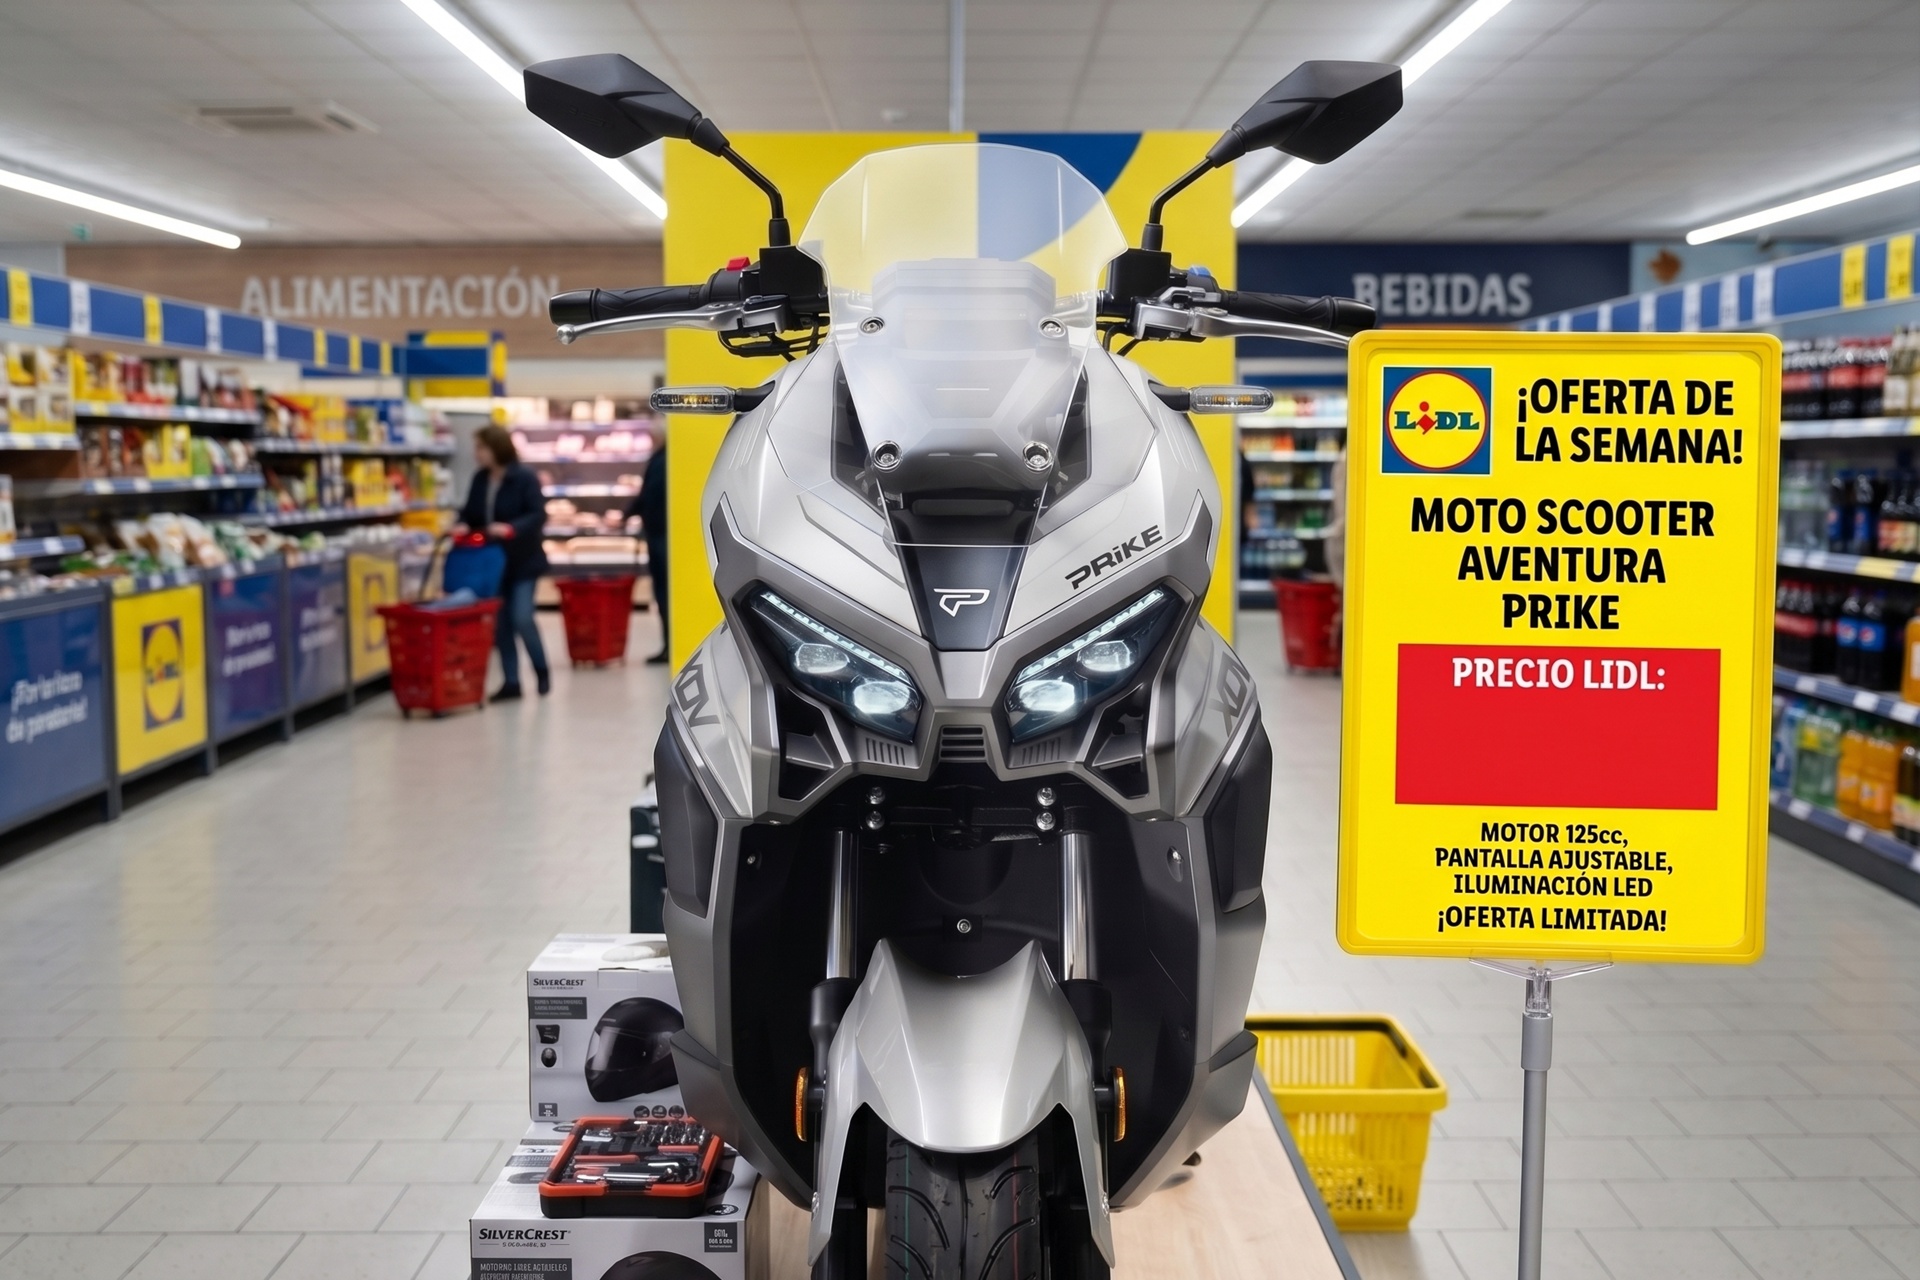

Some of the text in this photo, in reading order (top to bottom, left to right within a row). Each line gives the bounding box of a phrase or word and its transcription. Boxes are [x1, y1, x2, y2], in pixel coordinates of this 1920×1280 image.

[240, 266, 559, 318] ALIMENTACIÓN
[1352, 272, 1533, 317] BEBIDAS
[1517, 378, 1734, 423] ¡OFERTA DE
[1515, 426, 1743, 465] LA SEMANA!
[1411, 497, 1715, 537] MOTO SCOOTER
[1457, 545, 1667, 584] AVENTURA
[1502, 593, 1620, 630] PRIKE
[1452, 657, 1666, 691] PRECIO LIDL:
[1480, 822, 1629, 848] MOTOR 125cc,
[1435, 848, 1673, 875] PANTALLA AJUSTABLE,
[1454, 871, 1654, 897] ILUMINACIÓN LED
[1438, 906, 1667, 932] ¡OFERTA LIMITADA!
